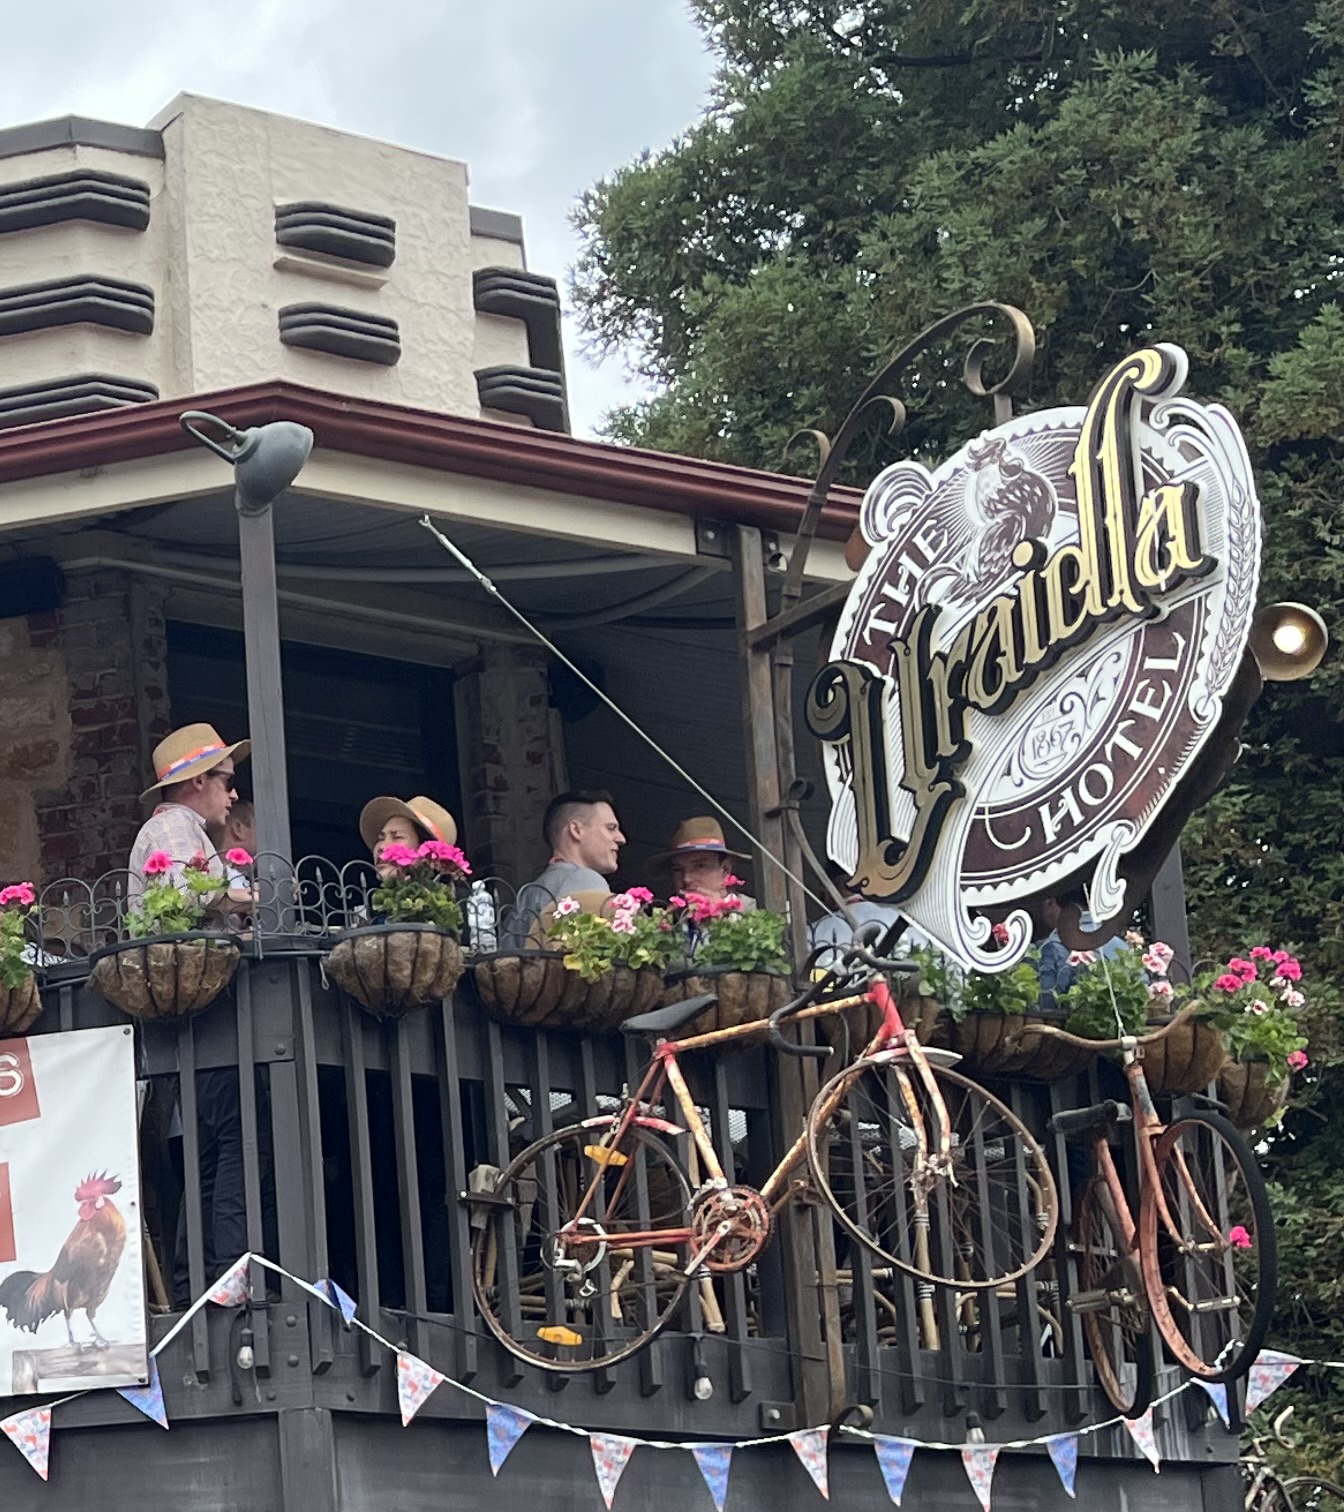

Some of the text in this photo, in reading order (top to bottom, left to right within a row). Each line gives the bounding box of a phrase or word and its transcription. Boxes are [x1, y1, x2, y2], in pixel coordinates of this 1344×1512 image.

[805, 342, 1218, 905] Uraidla
[864, 517, 954, 648] THE
[1037, 630, 1187, 846] HOTEL
